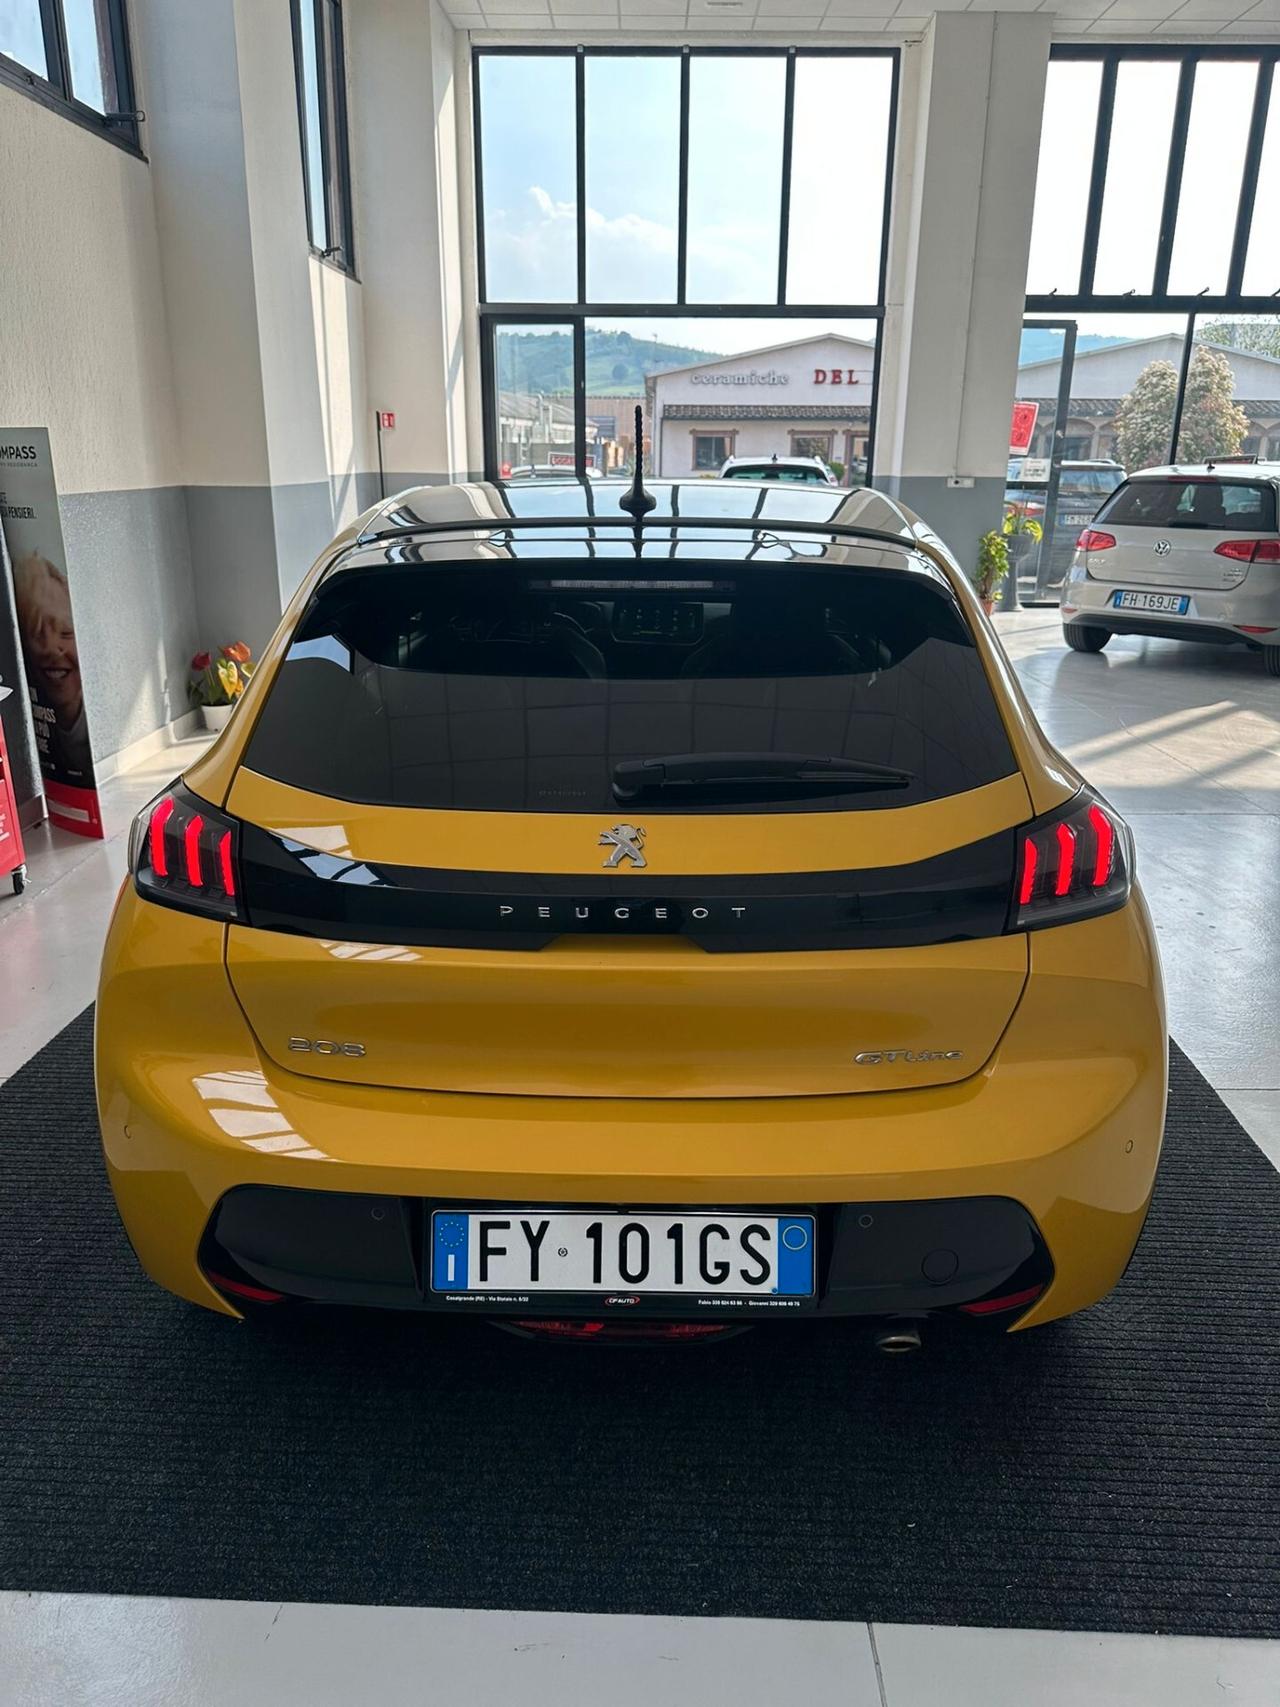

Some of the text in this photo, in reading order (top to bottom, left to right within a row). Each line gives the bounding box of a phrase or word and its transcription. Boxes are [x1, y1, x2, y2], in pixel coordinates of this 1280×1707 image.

[690, 369, 859, 385] ceramiche DEL
[0, 446, 37, 460] MPASS
[1122, 591, 1138, 606] FH
[1142, 593, 1179, 610] 169JE
[500, 905, 746, 919] PEUGEOT
[288, 1036, 367, 1057] 208
[478, 1220, 551, 1283] FY
[585, 1221, 772, 1286] 101GS
